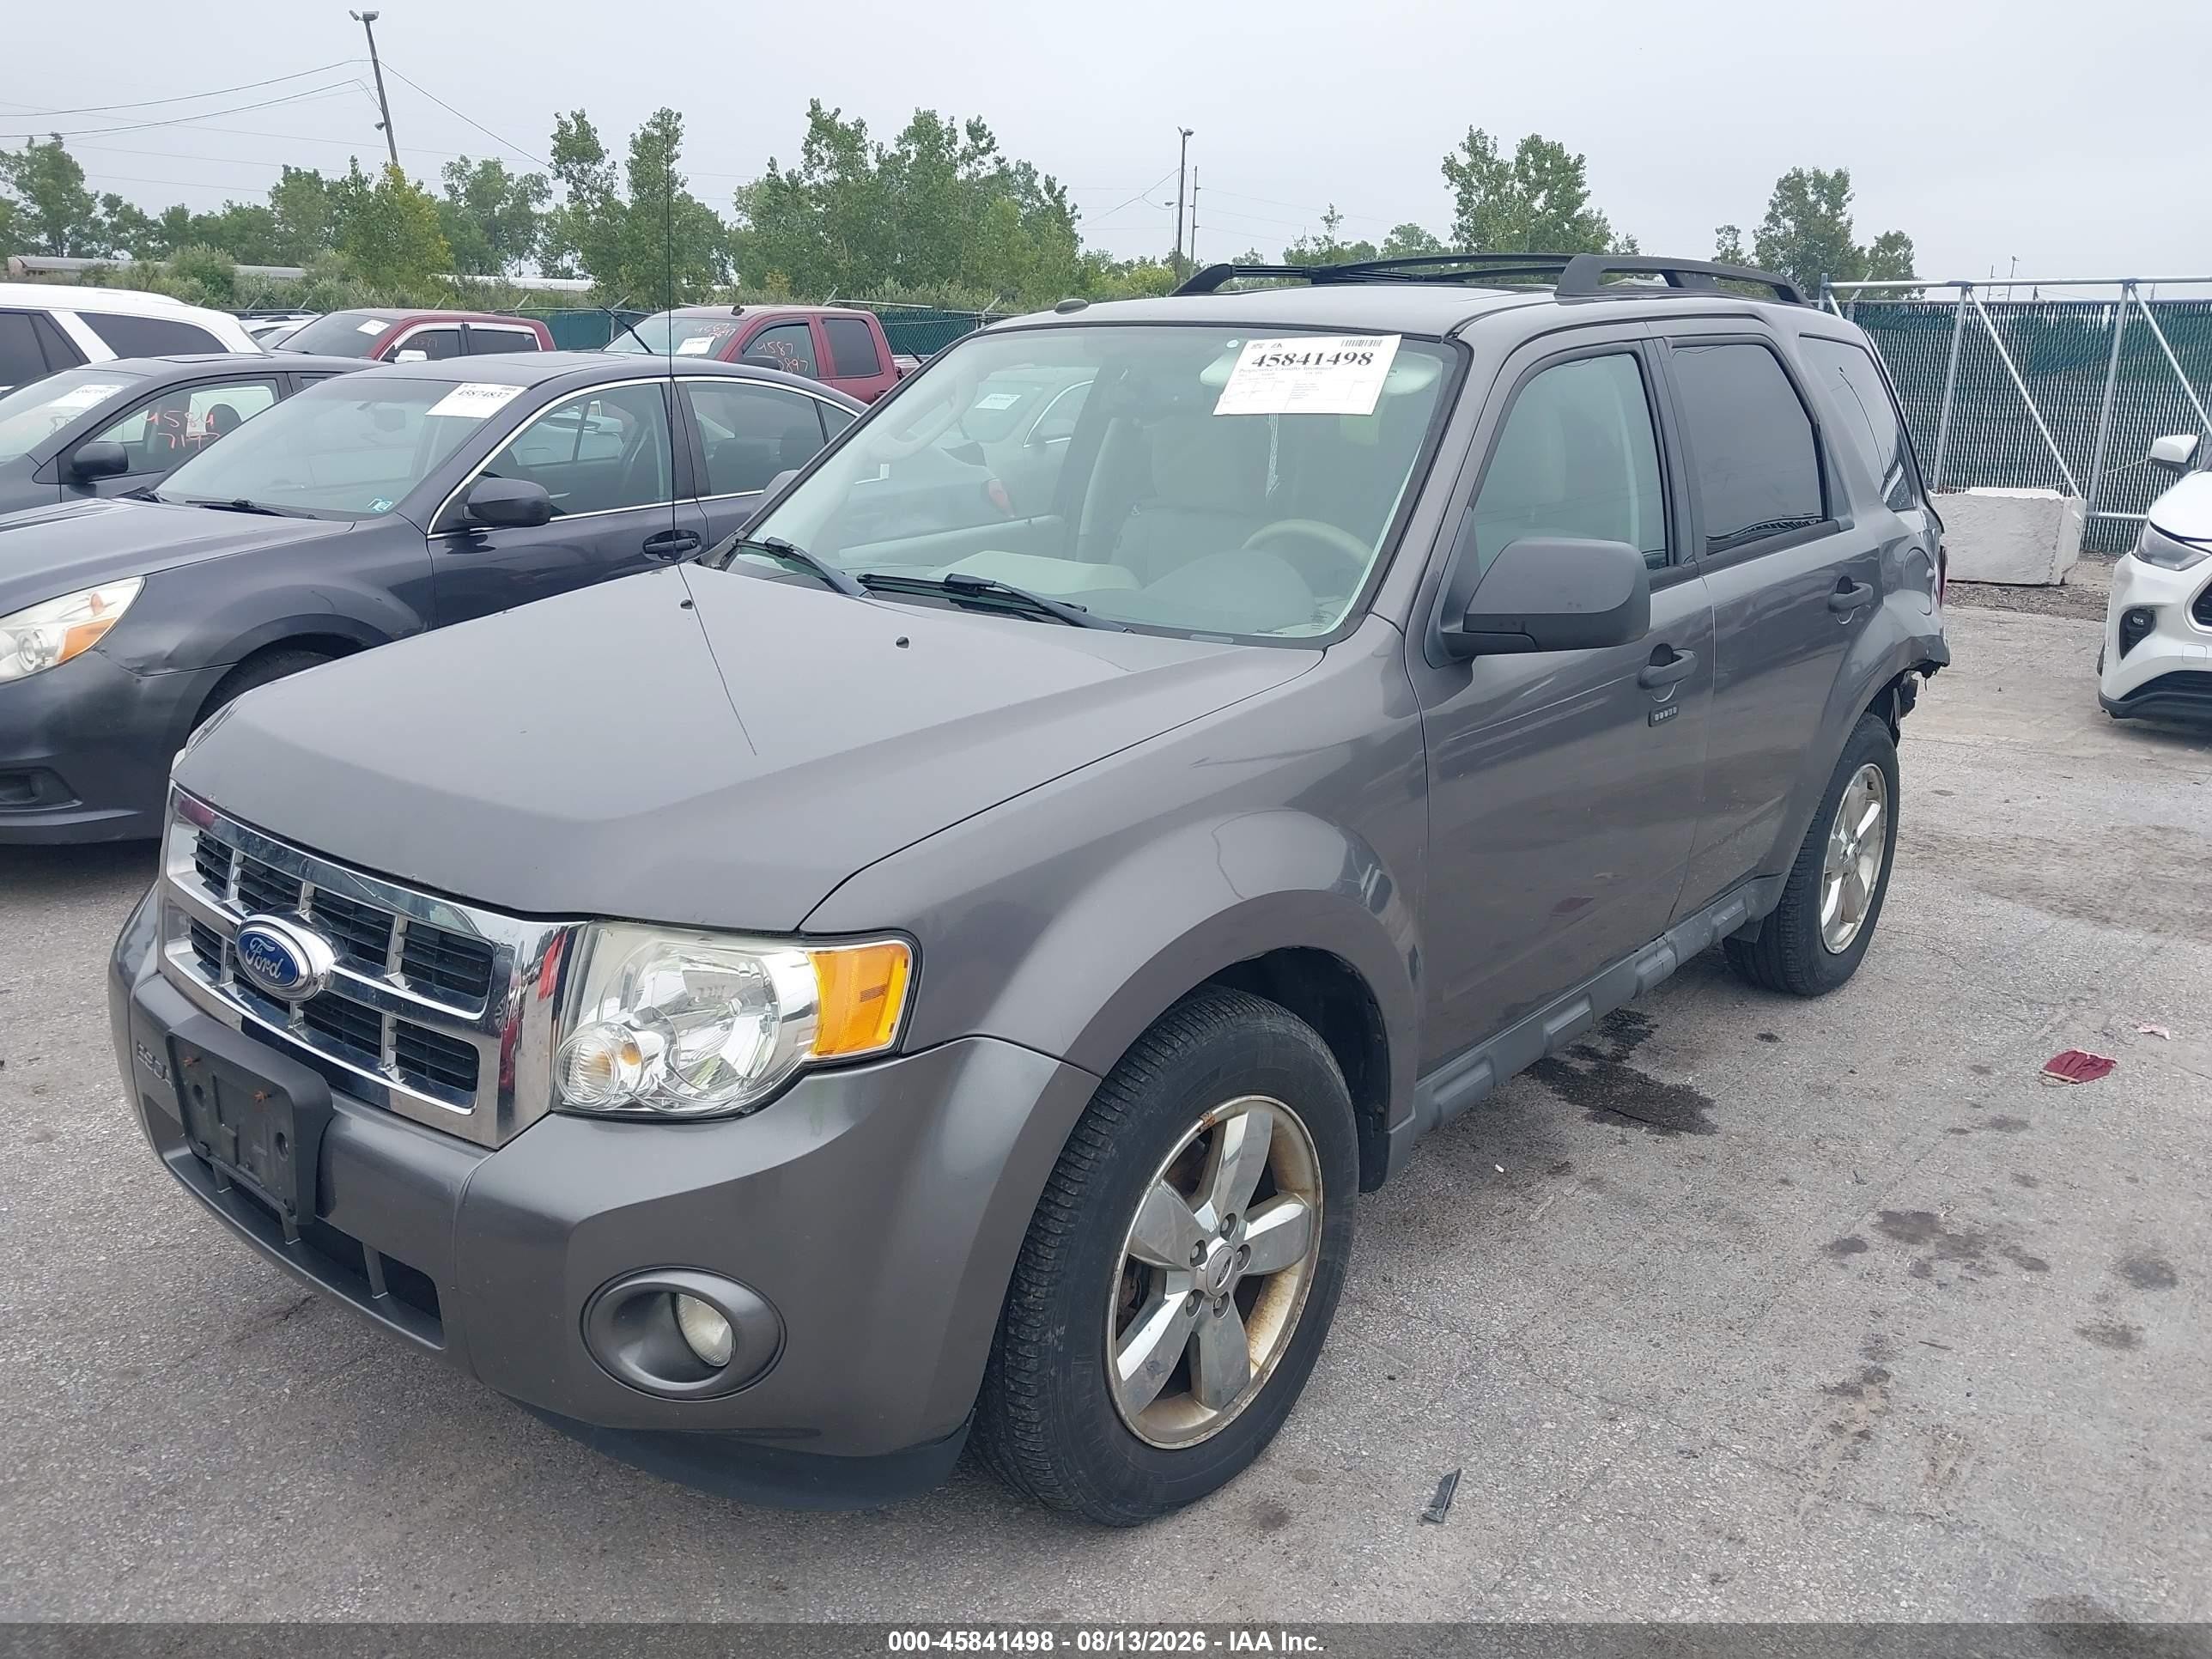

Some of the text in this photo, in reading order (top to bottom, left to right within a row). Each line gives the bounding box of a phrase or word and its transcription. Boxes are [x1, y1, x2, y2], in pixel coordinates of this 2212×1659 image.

[756, 341, 793, 356] 4587
[1251, 351, 1374, 368] 45841498
[246, 937, 284, 979] Ford
